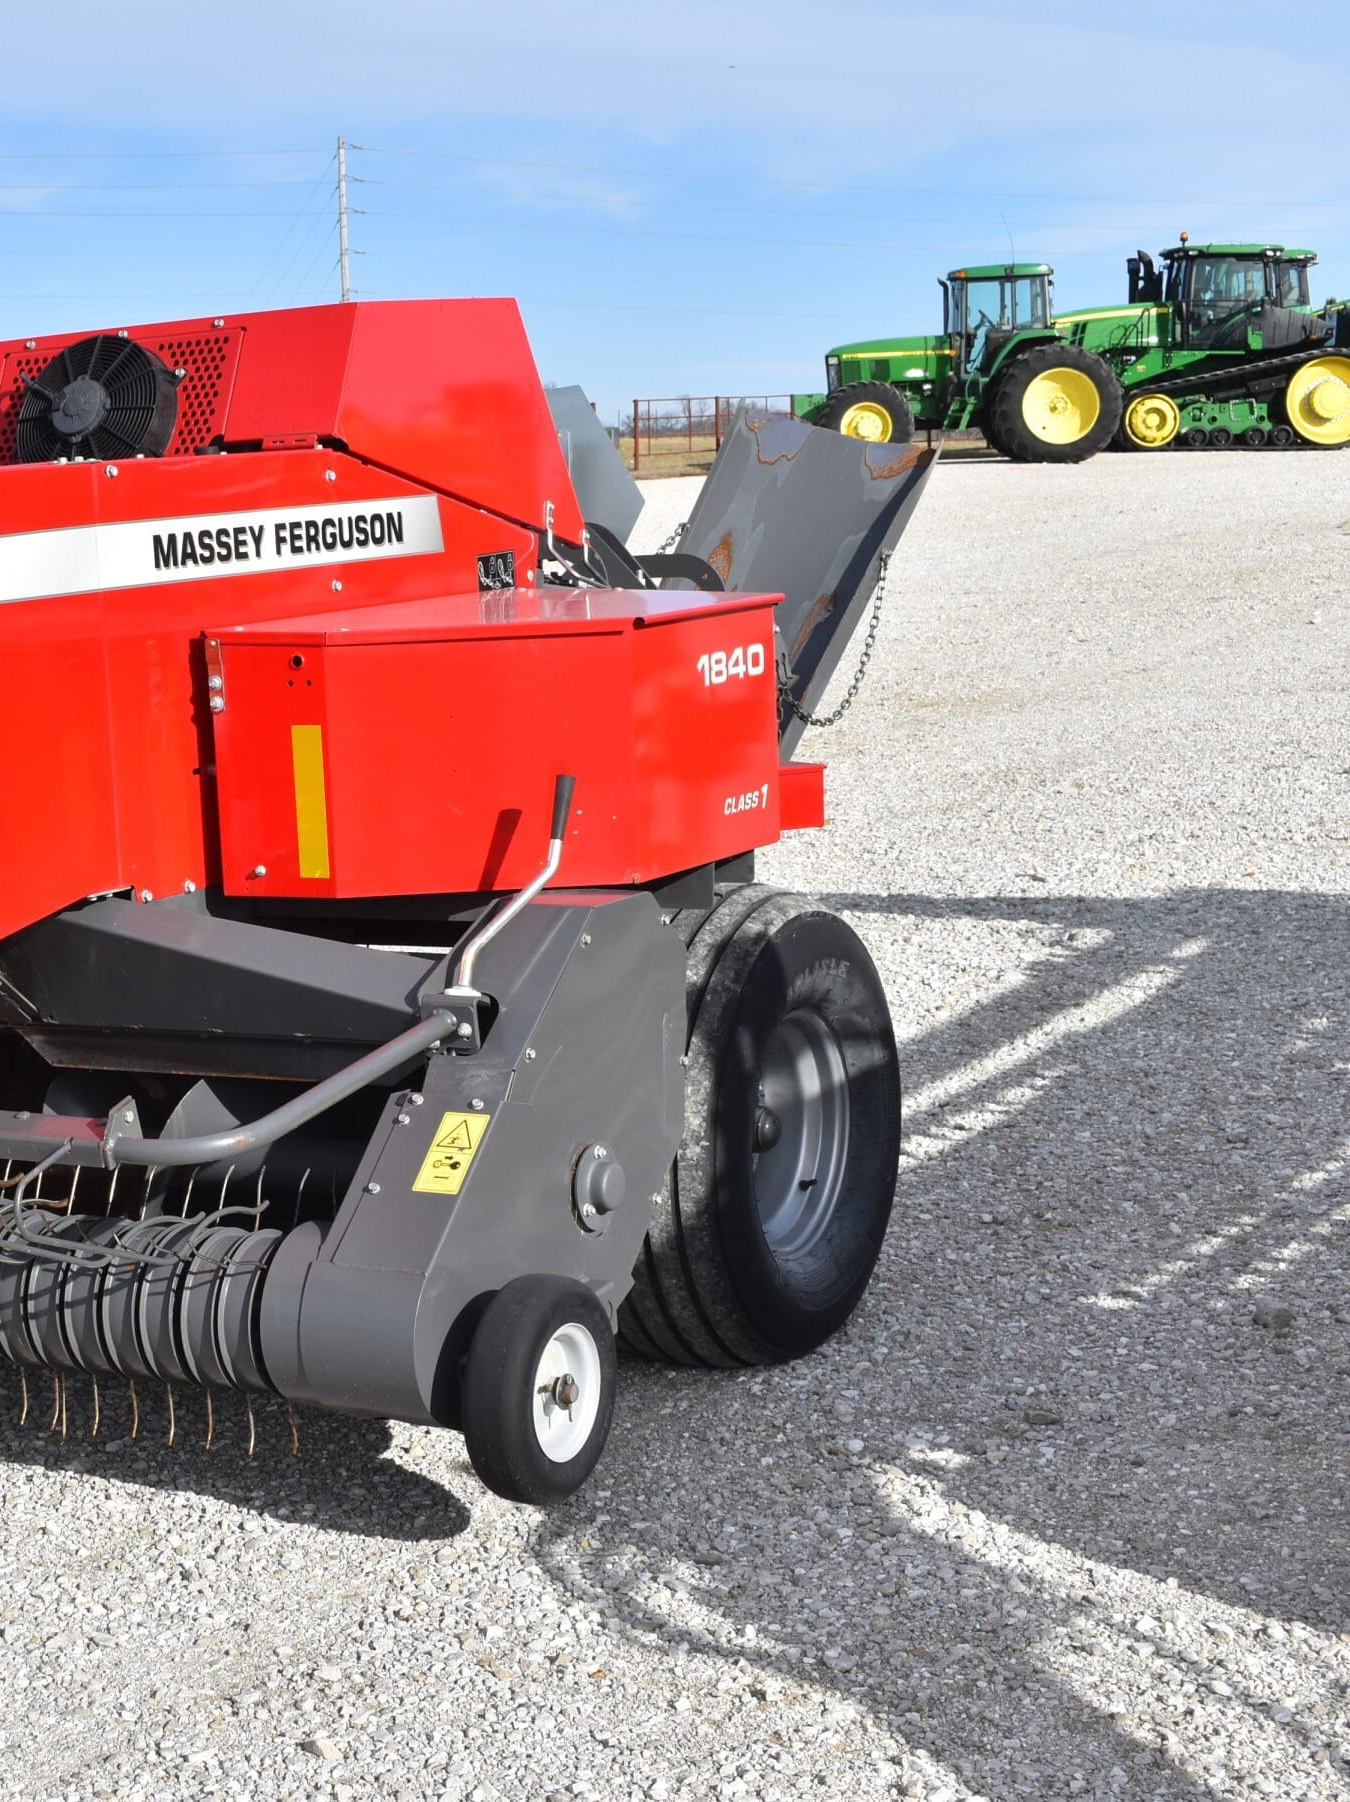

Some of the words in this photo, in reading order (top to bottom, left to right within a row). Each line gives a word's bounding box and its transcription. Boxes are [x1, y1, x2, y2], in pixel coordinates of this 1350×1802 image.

[152, 524, 265, 571] MASSEY
[274, 511, 405, 557] FERGUSON
[696, 643, 765, 688] 1840
[724, 790, 759, 816] CLASS
[761, 783, 769, 809] 1
